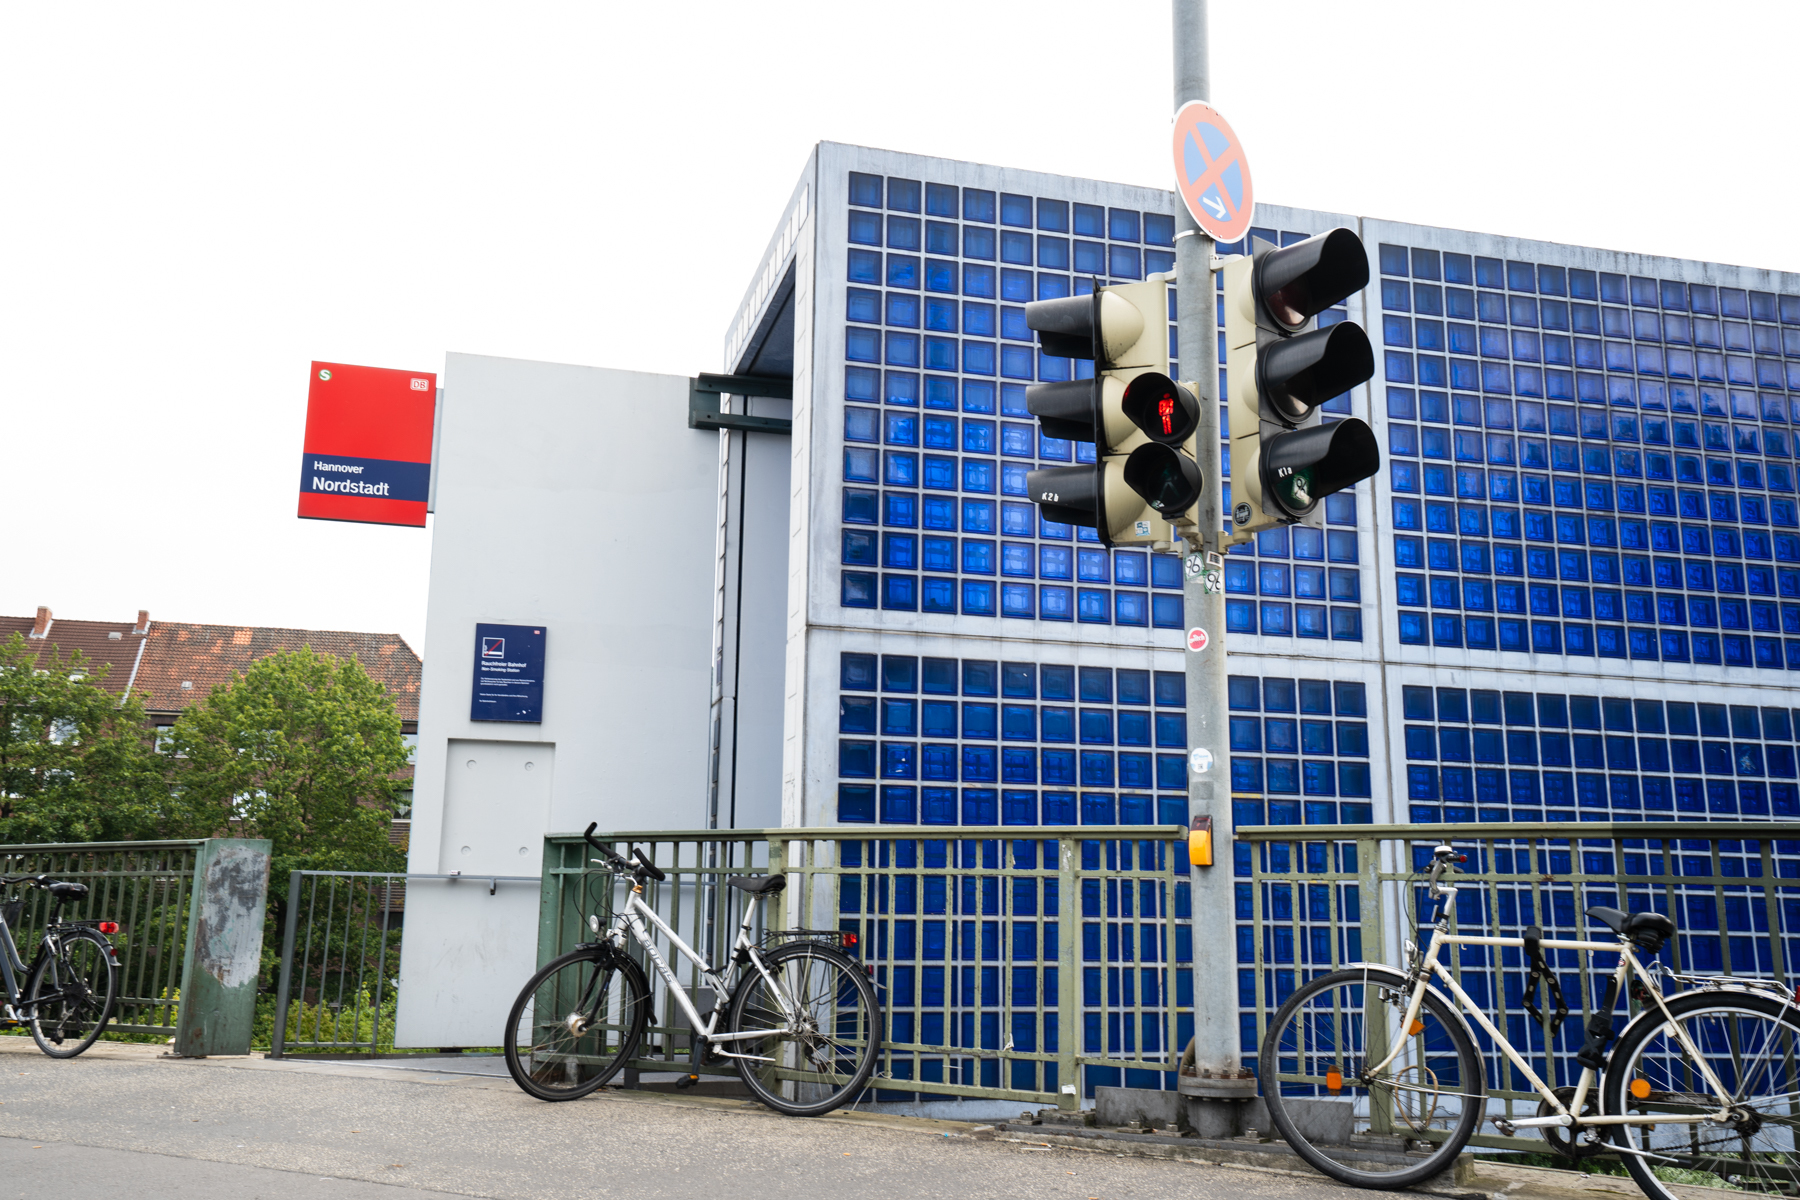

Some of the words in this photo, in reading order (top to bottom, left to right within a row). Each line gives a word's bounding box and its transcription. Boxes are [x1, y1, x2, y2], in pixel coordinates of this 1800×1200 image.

[319, 370, 332, 381] S
[412, 380, 427, 389] DB
[314, 460, 364, 474] Hannover
[312, 476, 390, 496] Nordstadt
